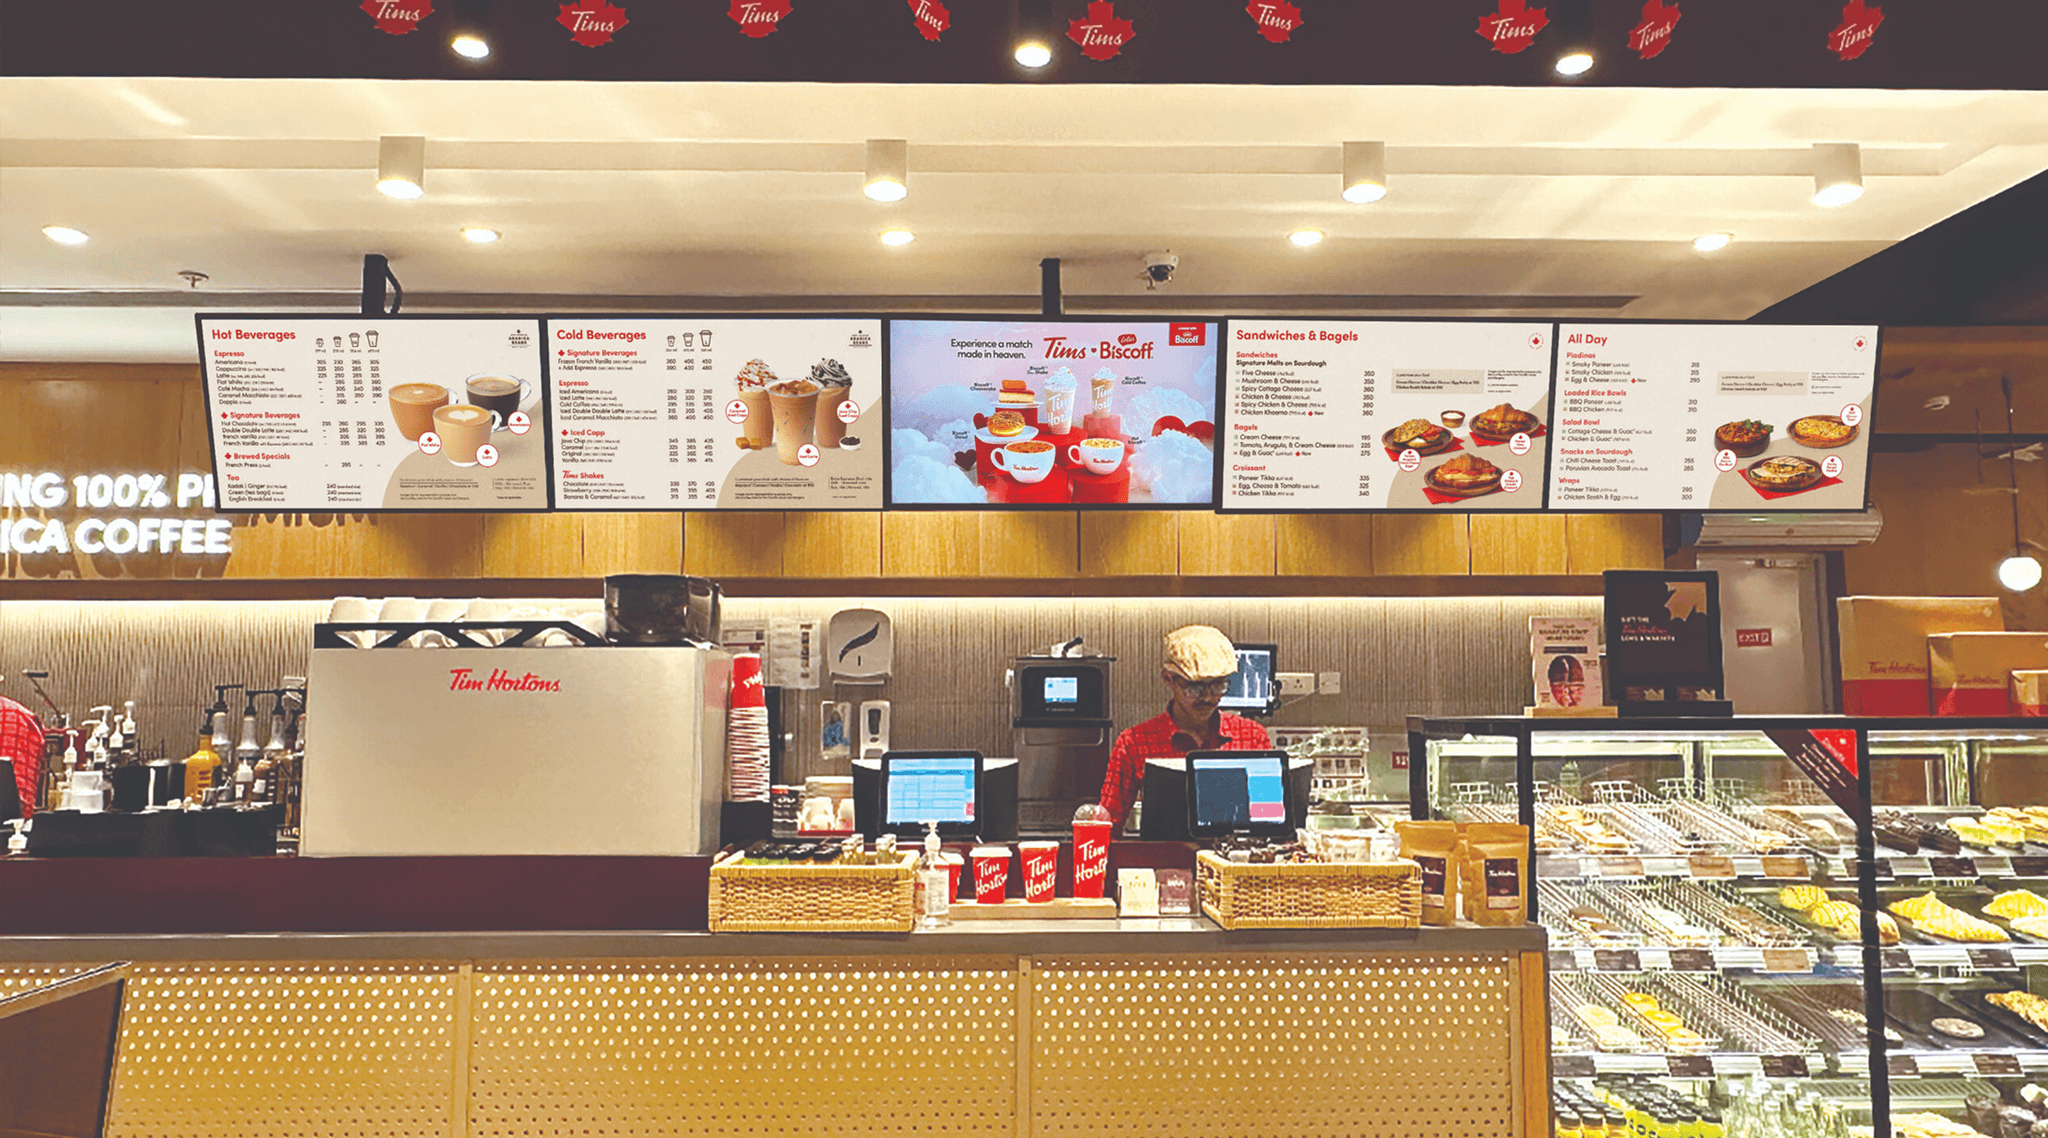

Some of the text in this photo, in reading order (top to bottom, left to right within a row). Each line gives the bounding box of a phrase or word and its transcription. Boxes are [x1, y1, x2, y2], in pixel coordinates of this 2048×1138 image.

[374, 0, 420, 21] Tims
[740, 4, 779, 24] Tims
[915, 0, 943, 31] Tims
[1258, 4, 1292, 30] Tims
[571, 11, 615, 32] Tims
[1490, 18, 1535, 41] Tims
[1080, 25, 1122, 46] Tims
[1637, 20, 1676, 49] Tims
[1837, 23, 1874, 51] Tims
[212, 329, 296, 342] Hot Beverages
[557, 329, 646, 342] Cold Beverages
[951, 339, 997, 349] Experience
[1006, 340, 1032, 349] match
[1175, 335, 1199, 343] Biscoff
[1237, 330, 1358, 344] Sandwiches & Bagels
[1568, 334, 1607, 346] All Day
[567, 349, 599, 357] Signature
[957, 350, 1026, 359] made in heaven.
[1044, 336, 1086, 359] Tims
[230, 412, 300, 420] Signature Beverages
[1234, 424, 1258, 432] Bagels
[262, 453, 290, 461] Specials
[73, 473, 171, 508] 100%
[74, 519, 232, 554] COFFEE
[450, 669, 561, 691] Tim Hortons
[1079, 840, 1105, 860] Tim
[977, 858, 1000, 878] Tim
[1027, 856, 1052, 878] Tim
